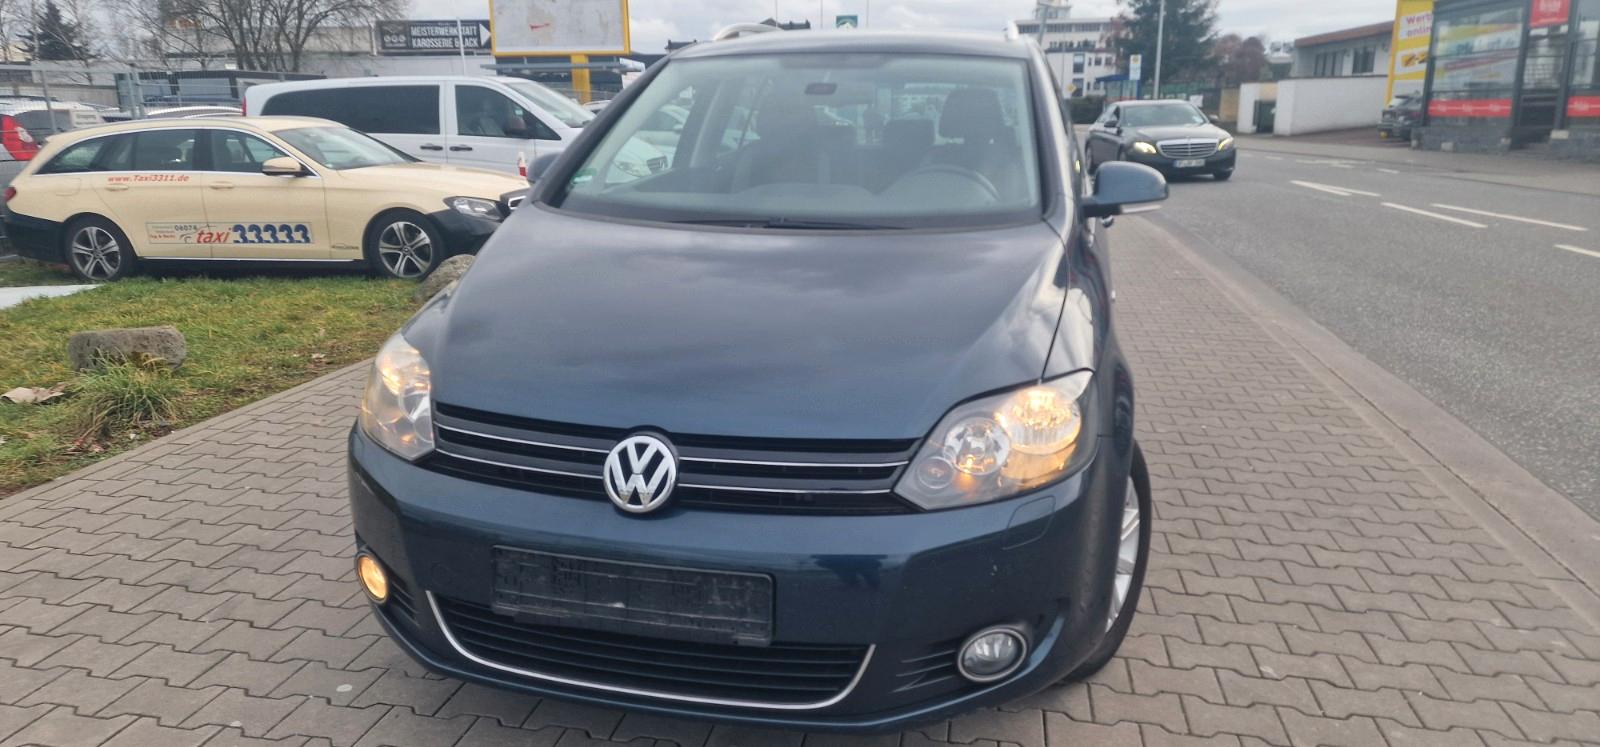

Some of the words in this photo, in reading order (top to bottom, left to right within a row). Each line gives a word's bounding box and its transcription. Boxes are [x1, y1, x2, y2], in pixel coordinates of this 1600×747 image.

[410, 26, 477, 36] MEISTERWERKTATT
[411, 37, 453, 48] KAROSSERIE
[461, 37, 479, 48] ACK
[107, 174, 190, 182] www.Taxi3311.de
[196, 227, 231, 244] taxi
[232, 223, 311, 244] 33333
[604, 436, 676, 512] VW
